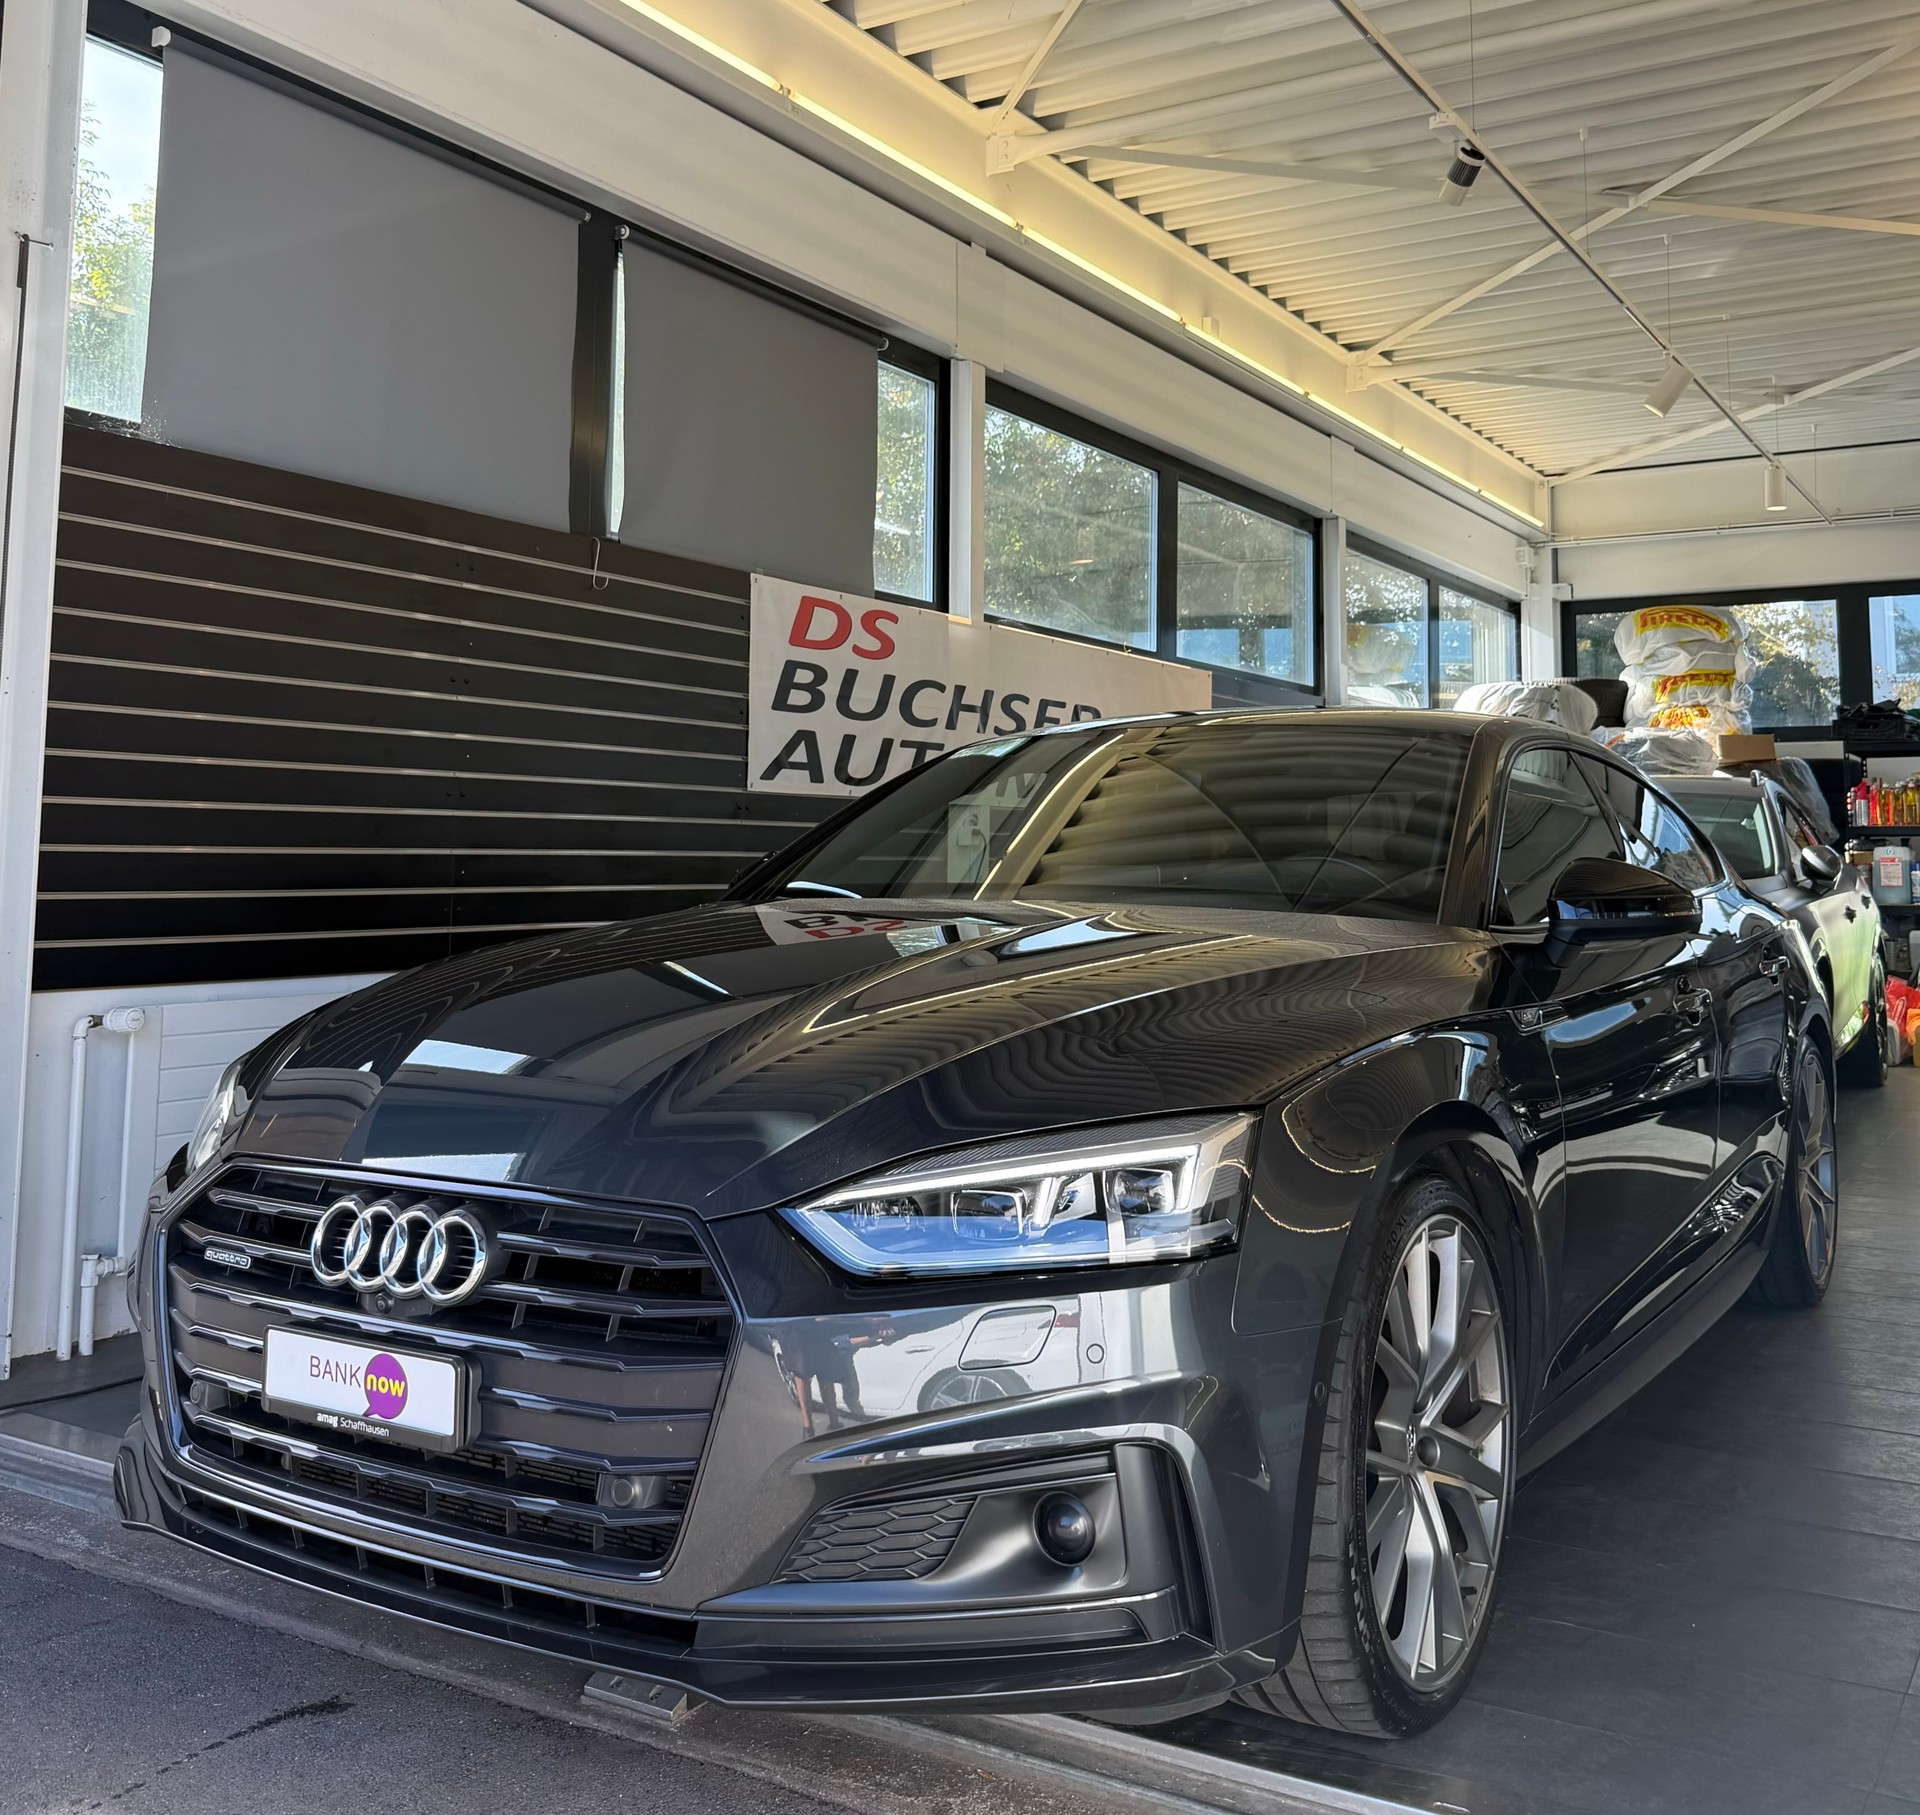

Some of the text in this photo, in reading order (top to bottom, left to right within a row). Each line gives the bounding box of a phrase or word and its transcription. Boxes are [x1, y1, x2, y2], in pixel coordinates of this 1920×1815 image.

[788, 596, 899, 659] DS
[206, 1250, 247, 1265] quattro
[310, 1355, 405, 1397] BANK now
[317, 1413, 390, 1437] amag Schaffhausen
